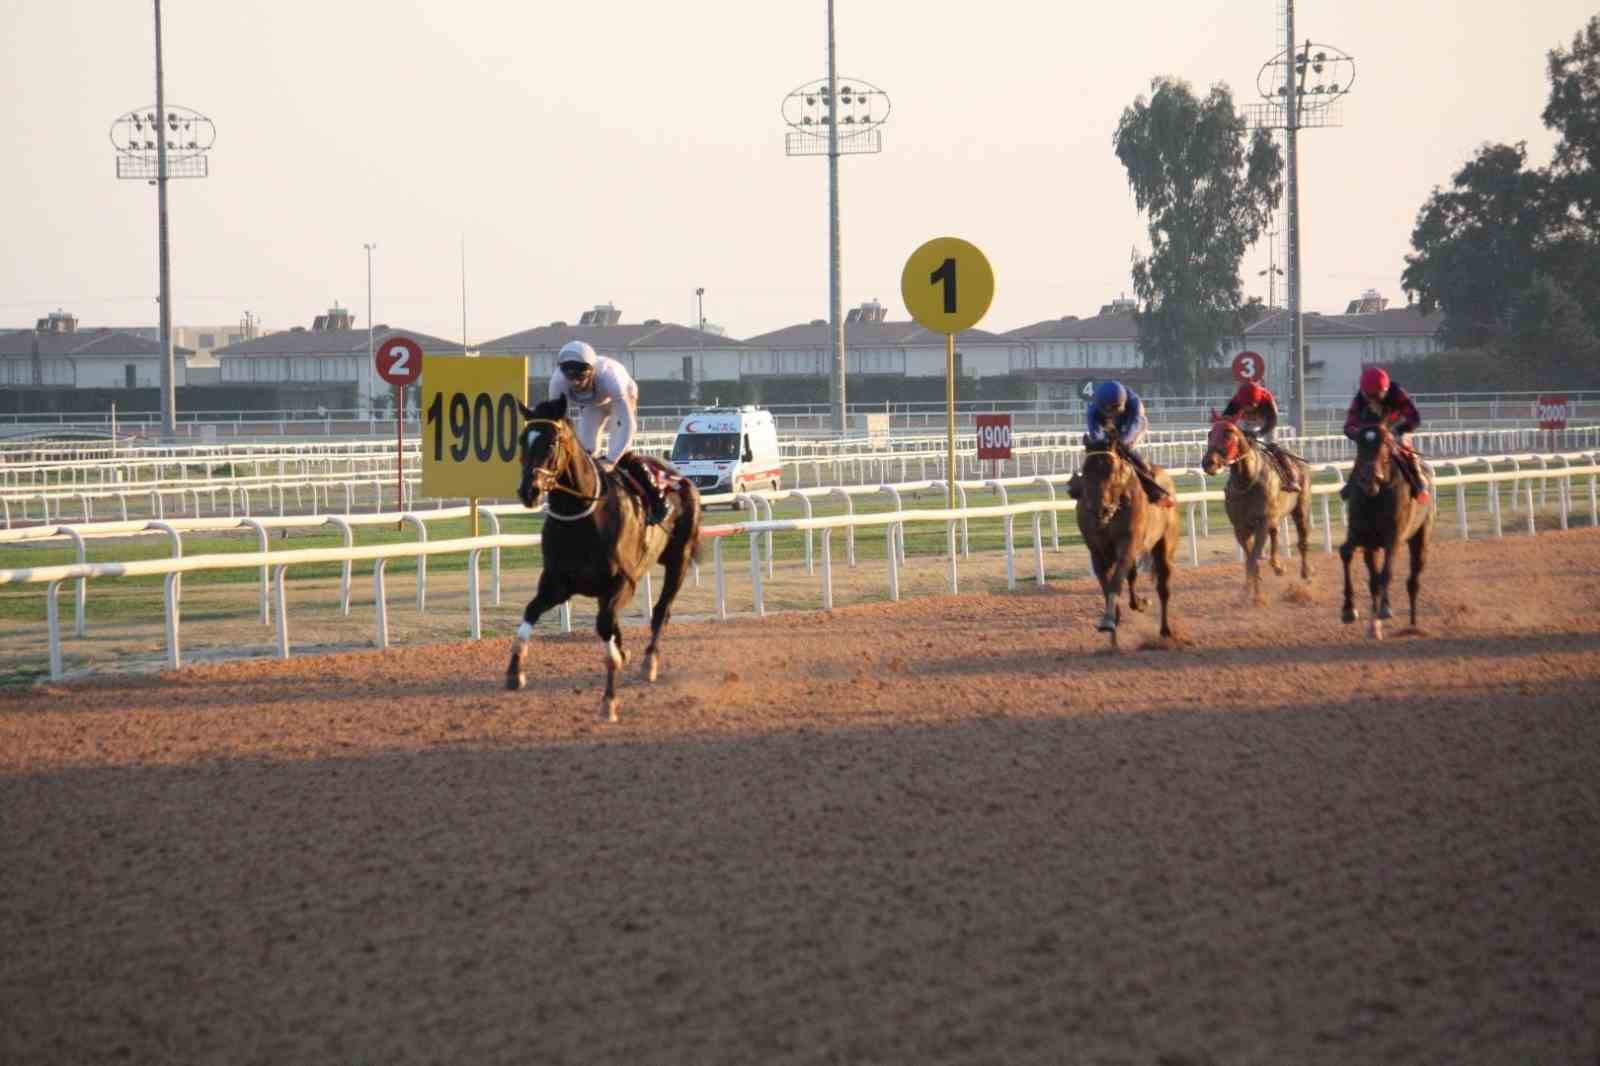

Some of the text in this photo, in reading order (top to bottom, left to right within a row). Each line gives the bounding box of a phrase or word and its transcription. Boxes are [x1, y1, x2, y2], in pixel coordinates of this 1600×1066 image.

[930, 258, 956, 313] 1
[388, 346, 410, 376] 2
[1240, 357, 1256, 378] 3
[1082, 381, 1094, 397] 4
[427, 391, 518, 463] 1900
[976, 425, 1011, 449] 1900
